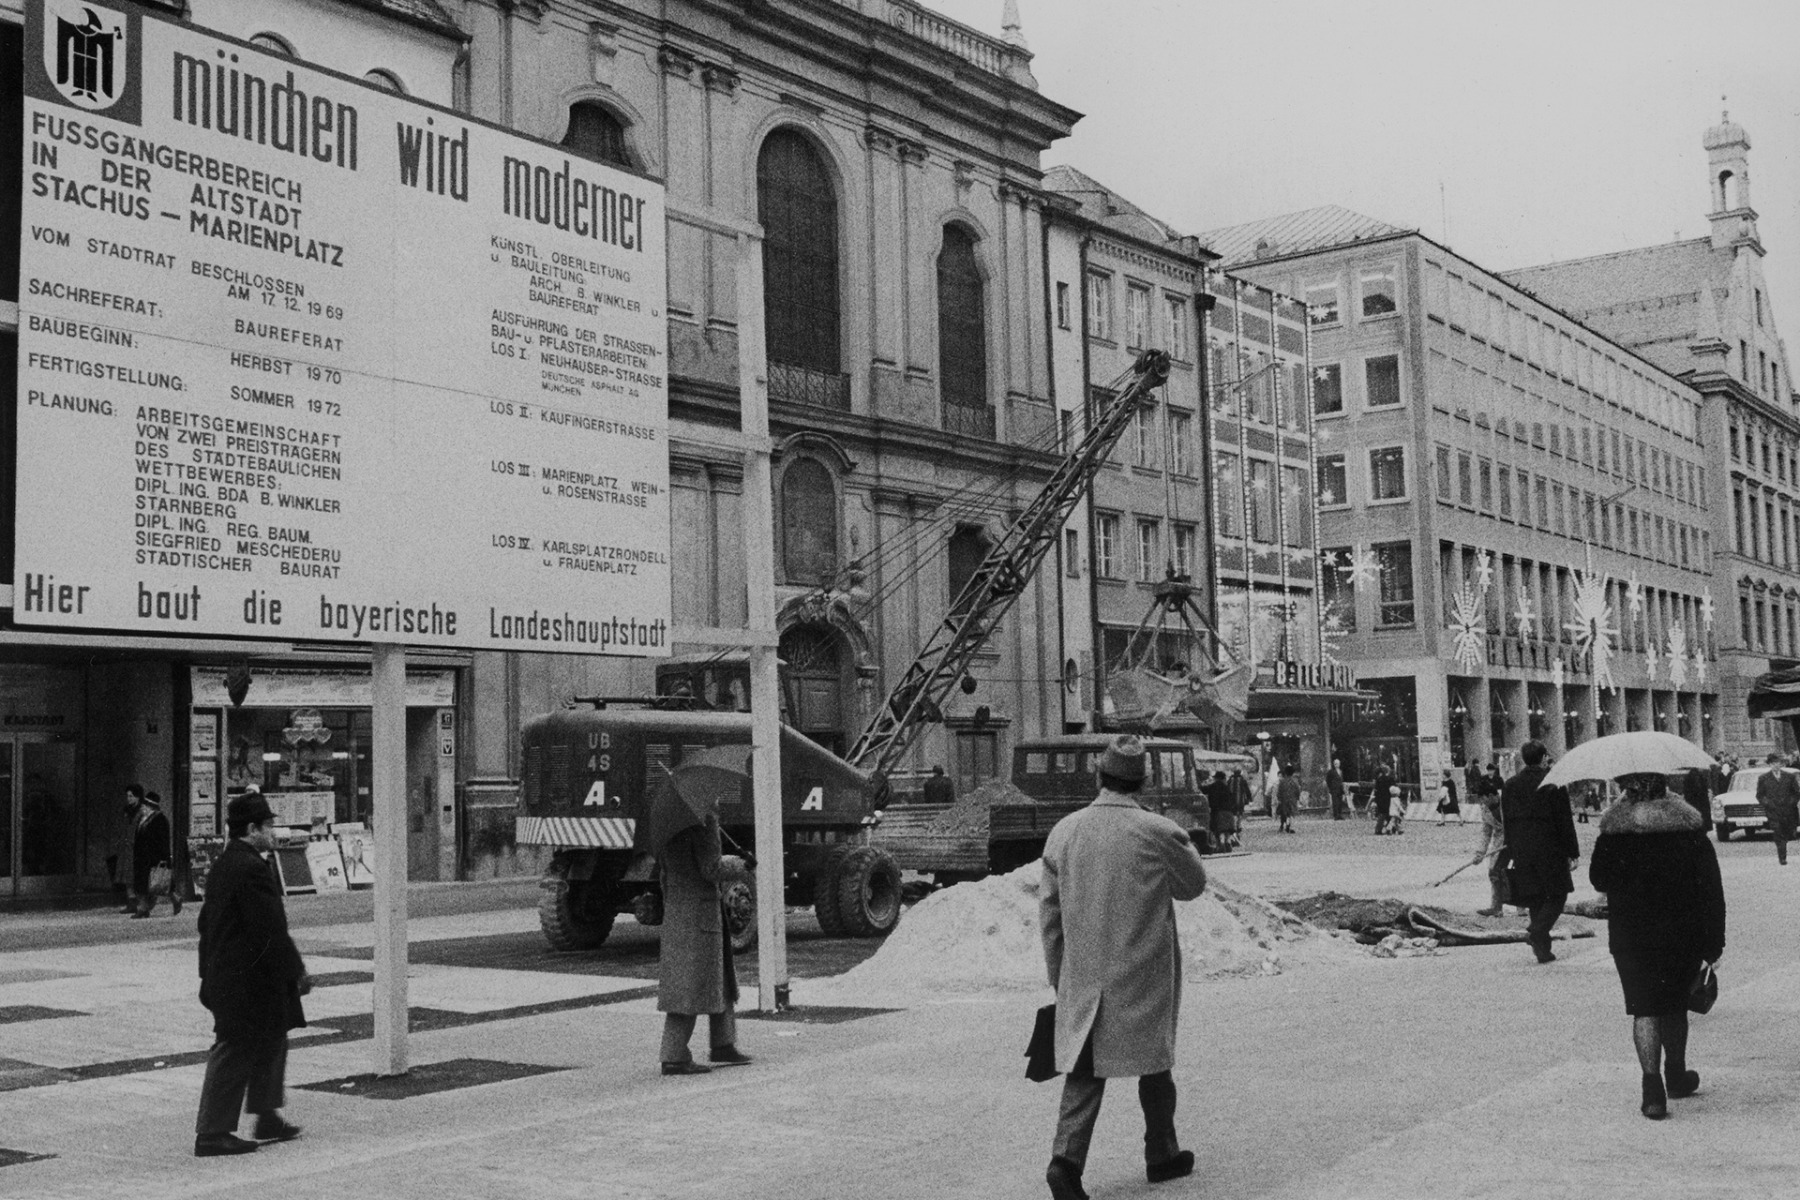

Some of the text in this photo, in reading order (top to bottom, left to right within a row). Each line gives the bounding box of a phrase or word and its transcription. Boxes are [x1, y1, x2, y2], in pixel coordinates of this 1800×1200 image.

[33, 111, 302, 203] FUSSGÄNGERBEREICH
[32, 142, 302, 230] IN DER ALTSTADT
[397, 116, 469, 203] wird
[503, 156, 646, 253] moderner
[32, 174, 150, 221] STACHUS
[190, 211, 343, 267] MARIENPLATZ
[31, 225, 304, 297] VOM STADTRAT BESCHLOSSEN
[552, 252, 630, 282] OBERLEITUNG
[227, 286, 250, 301] AM
[529, 290, 599, 315] BAUREFERAT
[593, 292, 640, 312] WINKLER
[235, 319, 343, 351] BAUREFERAT
[492, 310, 662, 357] AUSFÜHRUNG DER STRASSEN-
[231, 352, 293, 375] HERBST
[491, 343, 515, 358] LOS
[231, 386, 294, 409] SOMMER
[136, 406, 341, 447] ARBEITSGEMEINSCHAFT
[490, 402, 513, 416] LOS
[541, 411, 655, 440] KAUFINGERSTRASSE
[136, 423, 169, 441] VON
[177, 429, 216, 447] ZWEI
[135, 441, 341, 481] DES STÄDTEBAULICHEN
[491, 461, 515, 475] LOS
[631, 481, 665, 495] WEIN-
[135, 496, 237, 519] STARNBERG
[218, 487, 249, 503] BDA
[278, 494, 340, 513] WINKLER
[558, 486, 647, 508] ROSENSTRASSE
[135, 531, 221, 552] SIEGFRIED
[492, 535, 516, 548] LOS
[543, 541, 666, 564] KARLSPLATZRONDELL
[280, 562, 340, 579] BAURAT
[559, 558, 637, 575] FRAUENPLATZ
[24, 573, 666, 650] Hier baut die bayerische Landeshauptstadt
[588, 732, 610, 749] UB
[583, 780, 605, 806] A
[800, 786, 823, 811] A
